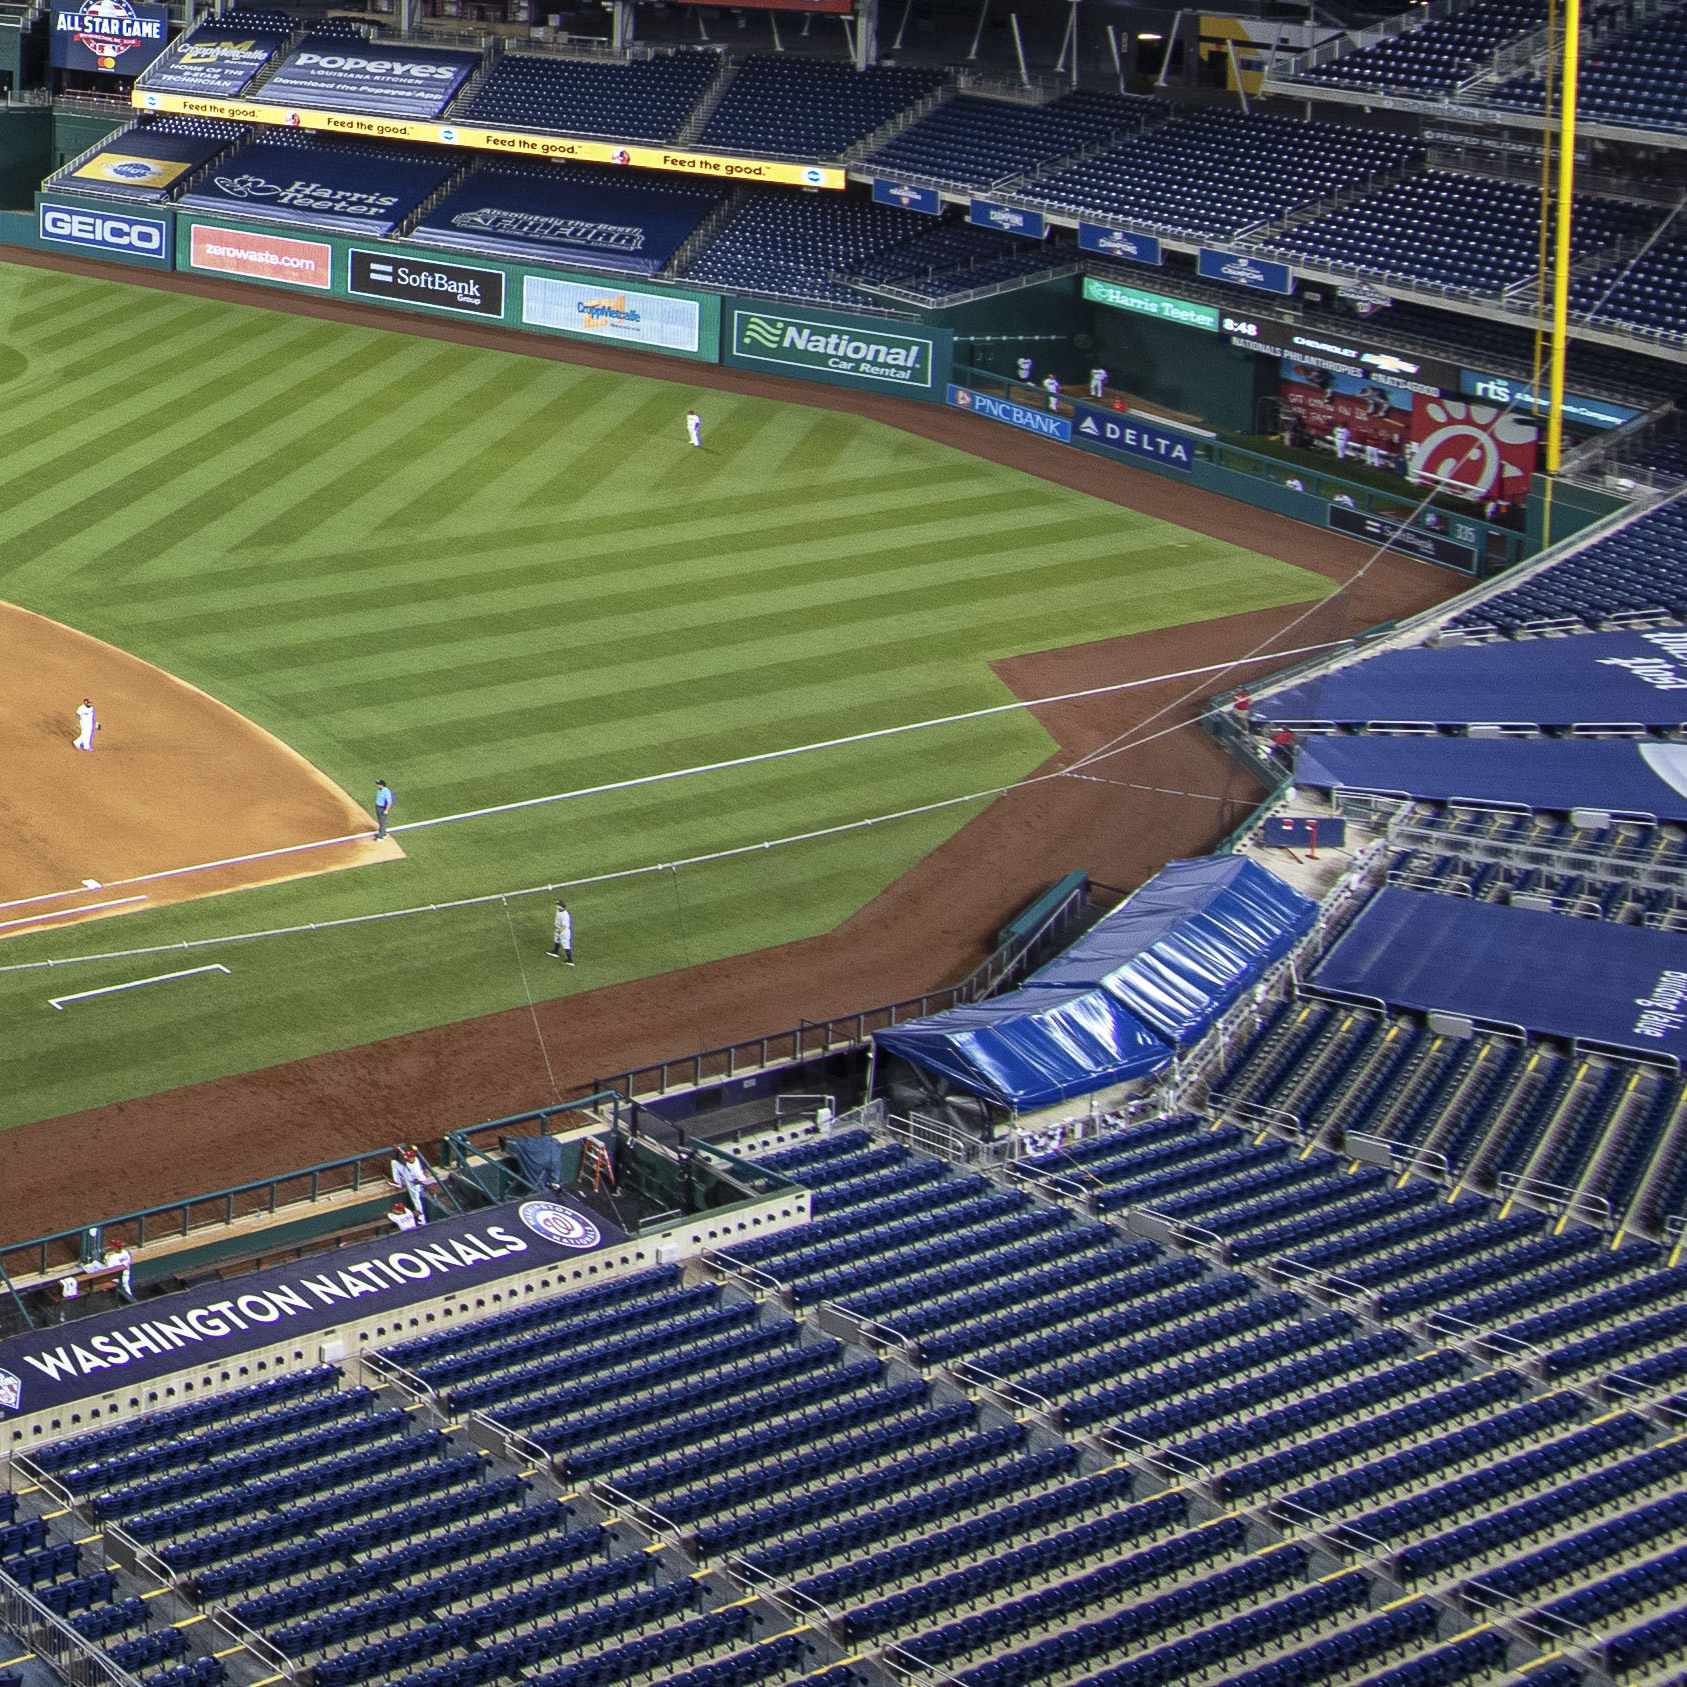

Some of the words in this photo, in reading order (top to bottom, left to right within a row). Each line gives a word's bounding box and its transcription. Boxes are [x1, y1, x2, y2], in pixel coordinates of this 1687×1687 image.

[57, 15, 82, 34] ALL
[84, 17, 120, 37] STAR
[123, 20, 161, 38] GAME
[170, 64, 204, 72] HOME
[310, 70, 370, 79] LOUISIANA
[373, 76, 423, 85] KITCHEN
[161, 75, 232, 87] TECHNICIAN
[273, 77, 334, 89] Download
[336, 83, 358, 91] the
[415, 91, 443, 101] App
[183, 101, 207, 112] Feed
[209, 103, 225, 114] the
[327, 117, 352, 128] Feed
[355, 119, 372, 131] the
[486, 136, 515, 147] Feed
[519, 139, 538, 151] the
[663, 156, 696, 168] Feed
[699, 158, 721, 171] the
[279, 192, 386, 216] Teeter
[286, 181, 398, 206] Harris
[45, 211, 160, 249] GEICO
[206, 243, 315, 271] zerowaste.com
[397, 268, 480, 297] SoftBank
[457, 294, 481, 305] Group
[1107, 289, 1159, 313] Harris
[1160, 301, 1214, 327] Teeter
[782, 325, 920, 367] National
[1232, 337, 1281, 357] NATIONALS
[1284, 350, 1364, 378] PHILANTHROPIES
[1293, 337, 1358, 358] CHEVROLET
[828, 358, 855, 370] Car
[859, 361, 911, 380] Rental
[974, 395, 1012, 420] PNC
[1013, 406, 1061, 437] BANK
[1107, 422, 1188, 462] DELTA
[23, 1284, 315, 1382] WASHINGTON
[301, 1227, 528, 1305] NATIONALS
